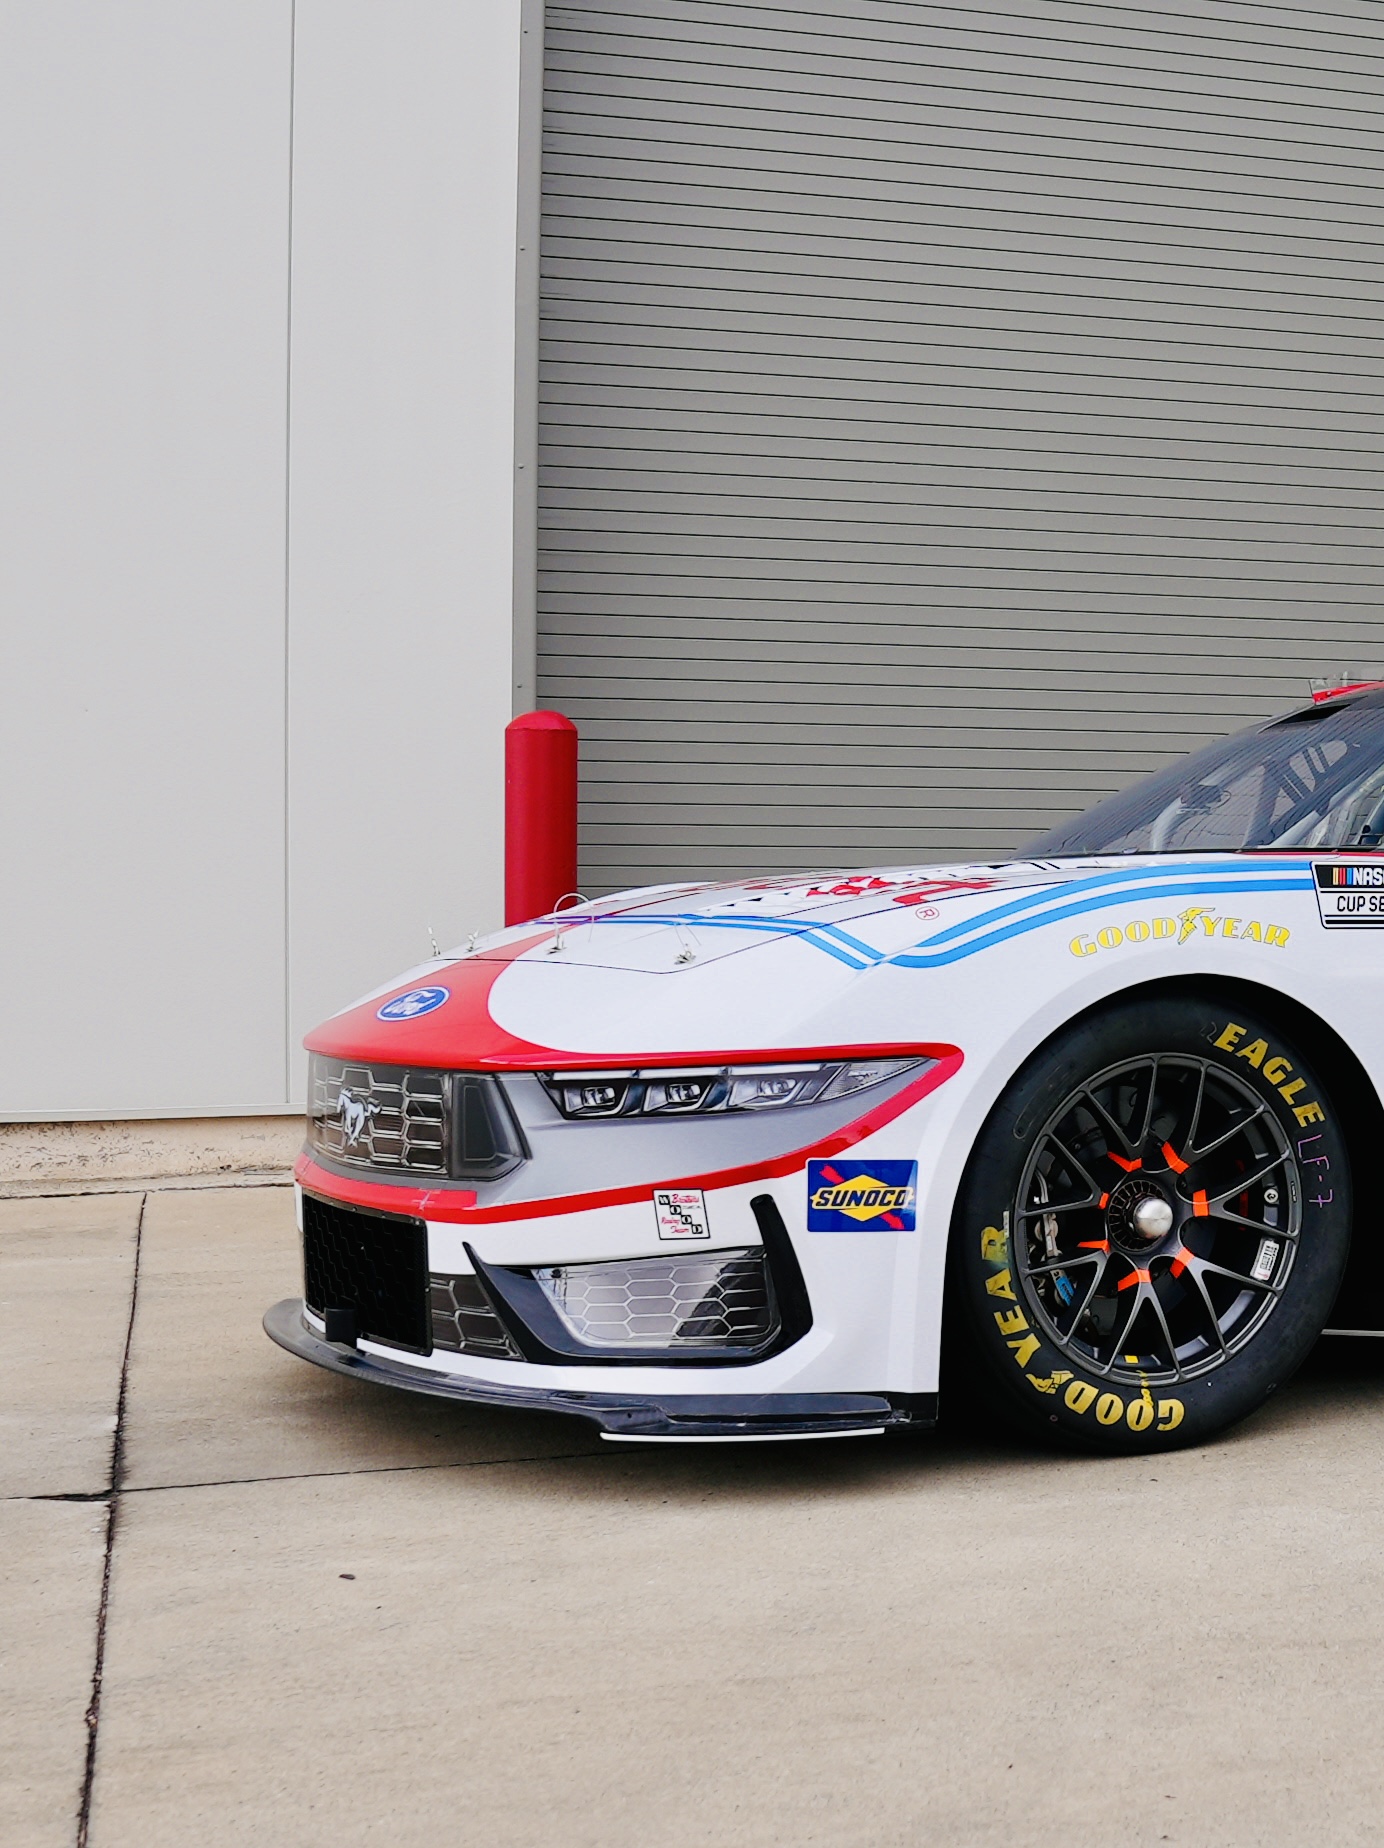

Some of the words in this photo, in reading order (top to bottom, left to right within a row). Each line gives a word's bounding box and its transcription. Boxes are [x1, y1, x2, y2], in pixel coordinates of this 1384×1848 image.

[1337, 895, 1366, 912] CUP
[1069, 907, 1291, 957] GOODYEAR
[1213, 1022, 1326, 1128] EAGLE
[815, 1189, 907, 1207] SUNOCO
[980, 1225, 1186, 1431] GOODYEAR
